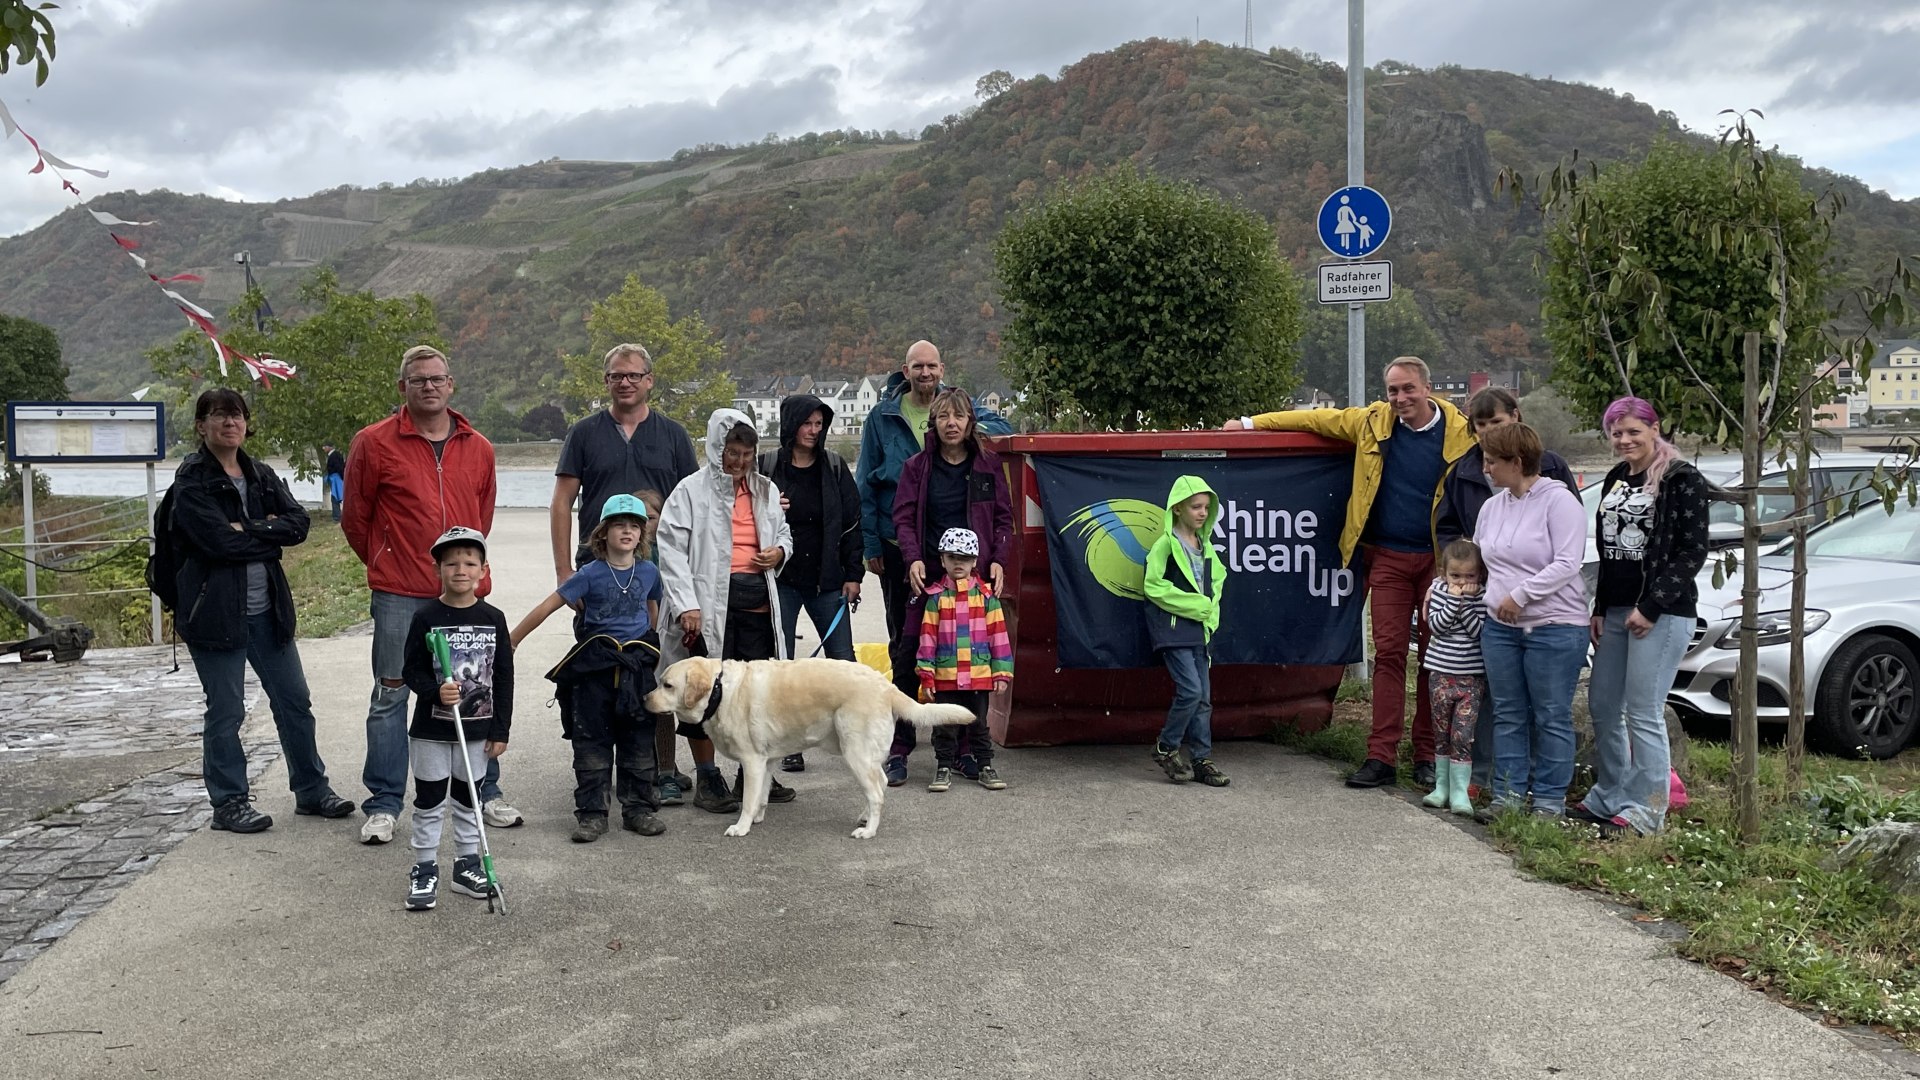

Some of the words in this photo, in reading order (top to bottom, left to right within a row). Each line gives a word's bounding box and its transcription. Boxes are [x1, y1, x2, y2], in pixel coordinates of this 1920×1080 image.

[1327, 271, 1383, 282] Radfahrer
[1328, 284, 1382, 295] absteigen
[1212, 531, 1316, 573] lean
[1308, 563, 1354, 607] up
[452, 642, 489, 650] GALAXY
